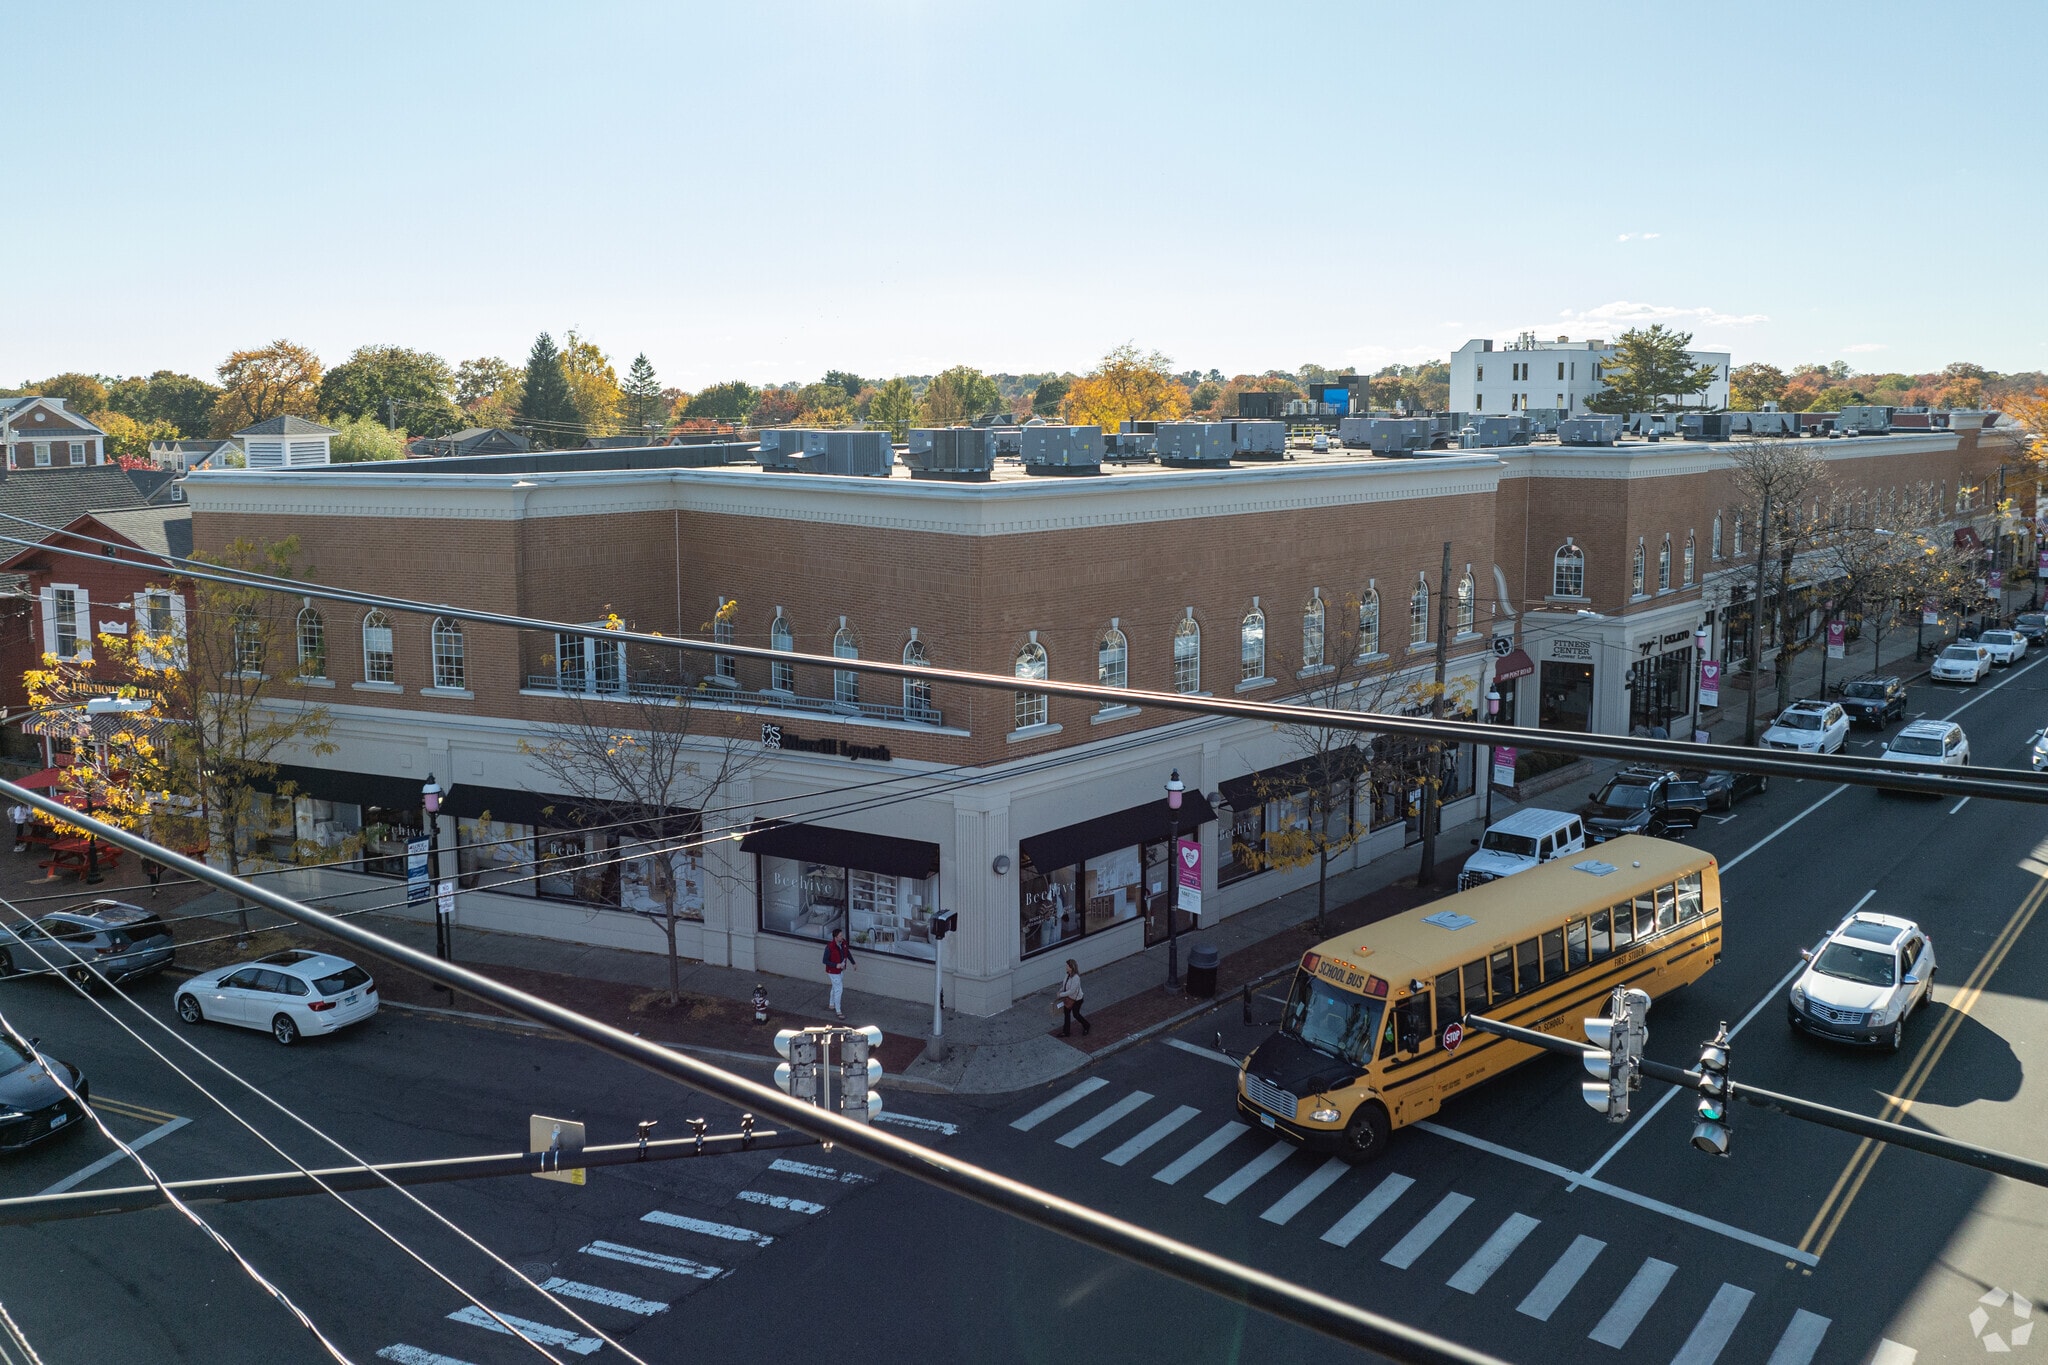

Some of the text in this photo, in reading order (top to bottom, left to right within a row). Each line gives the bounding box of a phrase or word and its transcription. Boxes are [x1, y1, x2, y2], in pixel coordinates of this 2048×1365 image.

[1553, 639, 1591, 649] FITNESS
[1664, 630, 1690, 645] GELATO
[1553, 647, 1590, 656] CENTER
[1509, 669, 1520, 678] POST
[1520, 666, 1532, 676] ROAD
[71, 681, 128, 695] FIREHOUS
[783, 733, 891, 761] Merrill Lynch
[1219, 820, 1258, 841] Beehive
[774, 872, 832, 894] Beehive
[1614, 945, 1647, 967] FIRST STUDENT
[1318, 961, 1365, 989] SCHOOL BUS
[1543, 1015, 1565, 1032] SCHOOLS
[1446, 1031, 1460, 1044] STOP
